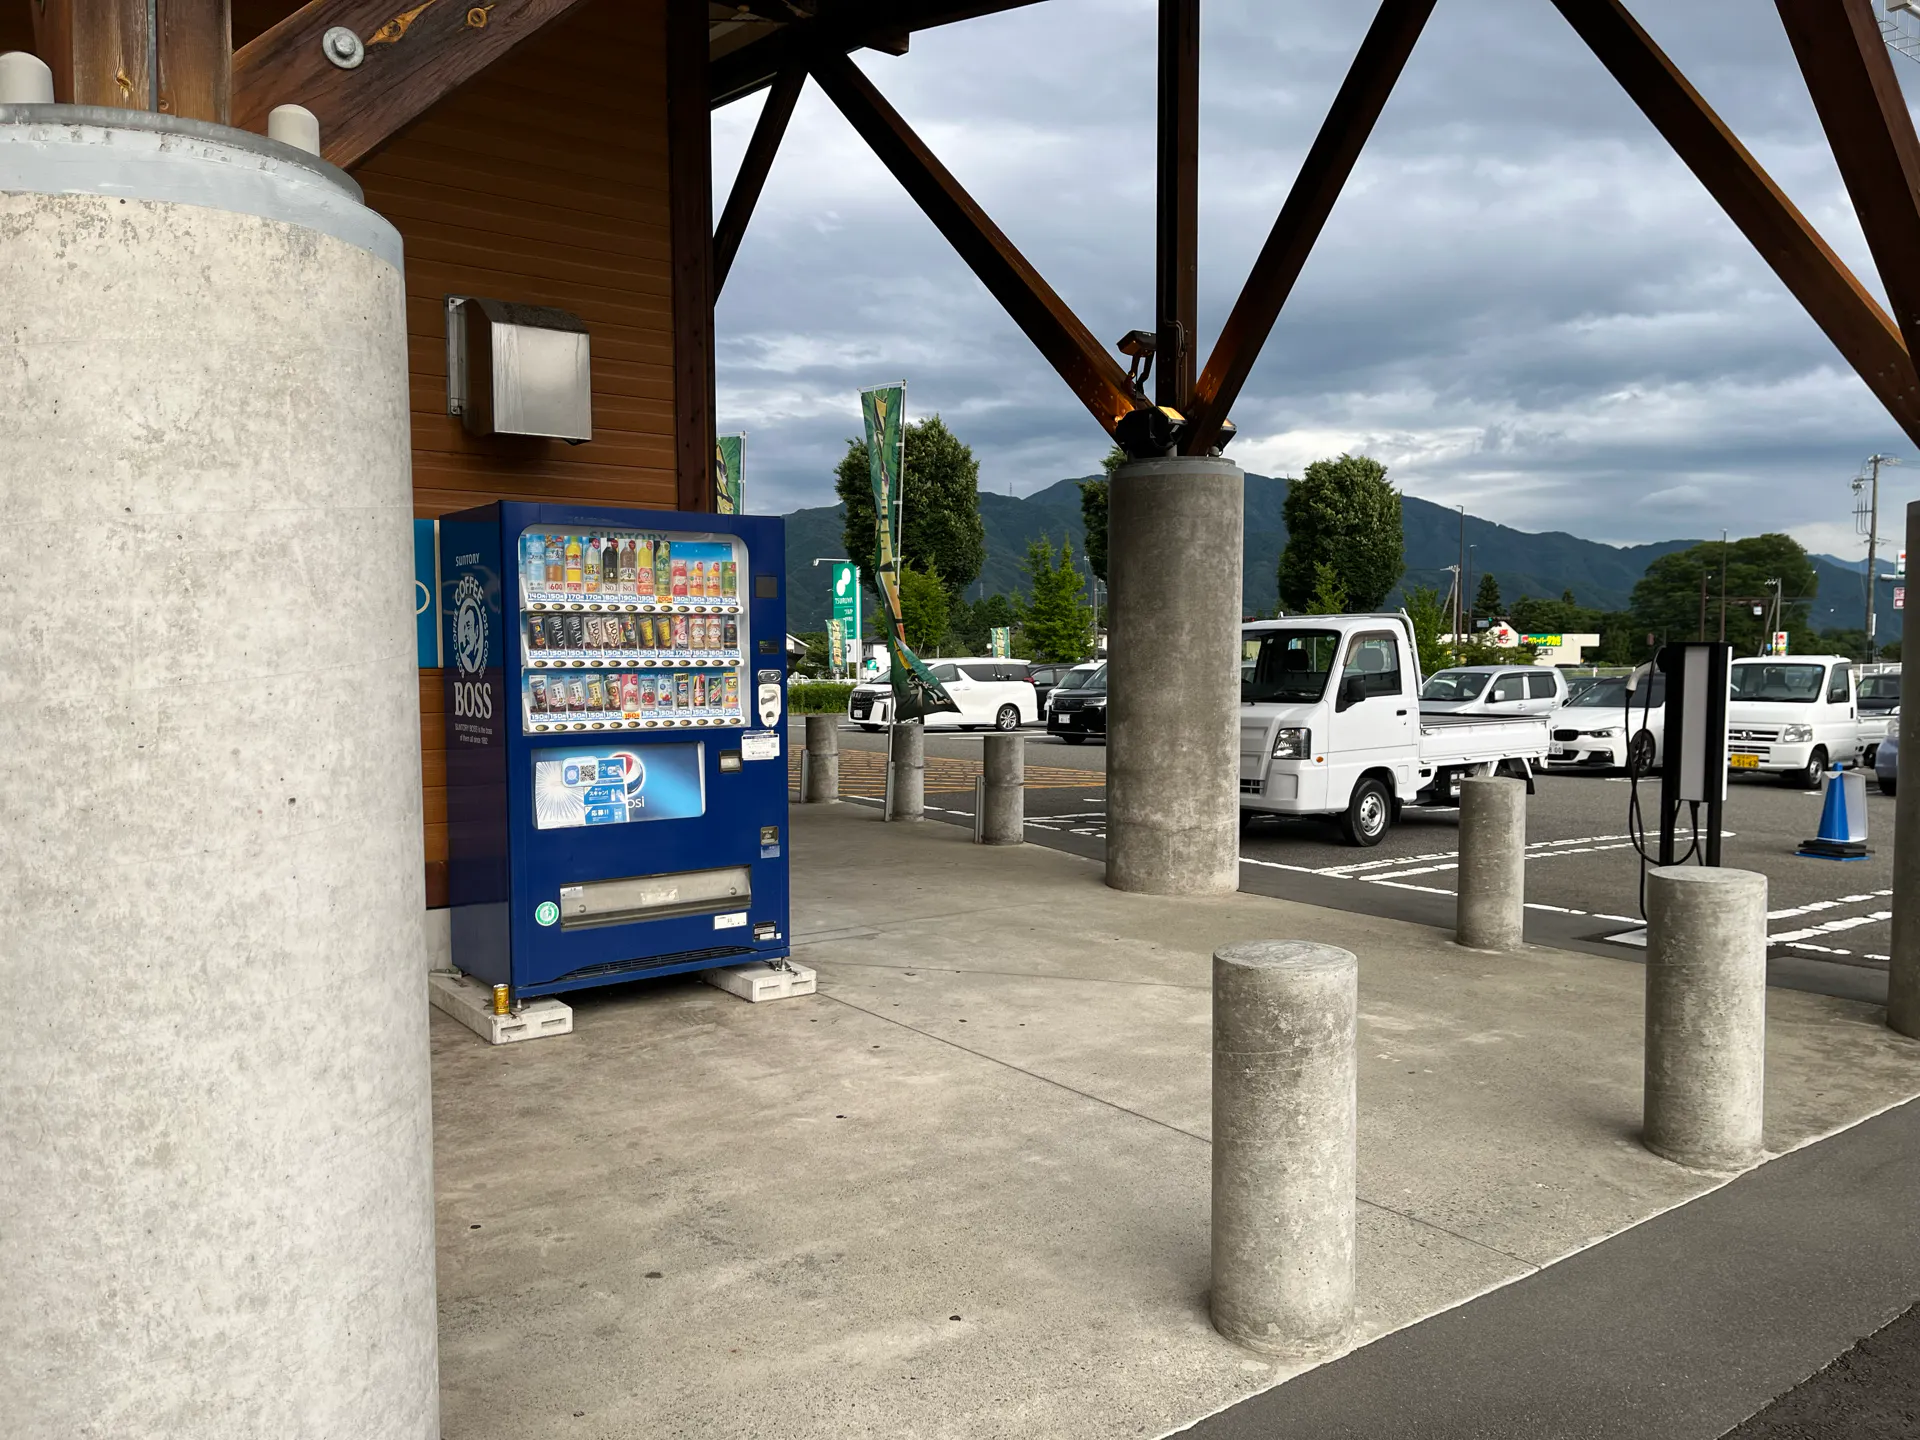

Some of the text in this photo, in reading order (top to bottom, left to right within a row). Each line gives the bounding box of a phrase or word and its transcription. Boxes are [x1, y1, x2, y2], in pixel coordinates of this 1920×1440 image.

[456, 553, 480, 566] SUNTORY
[454, 576, 484, 606] COFFEE
[454, 682, 492, 719] BOSS
[627, 796, 645, 808] psi
